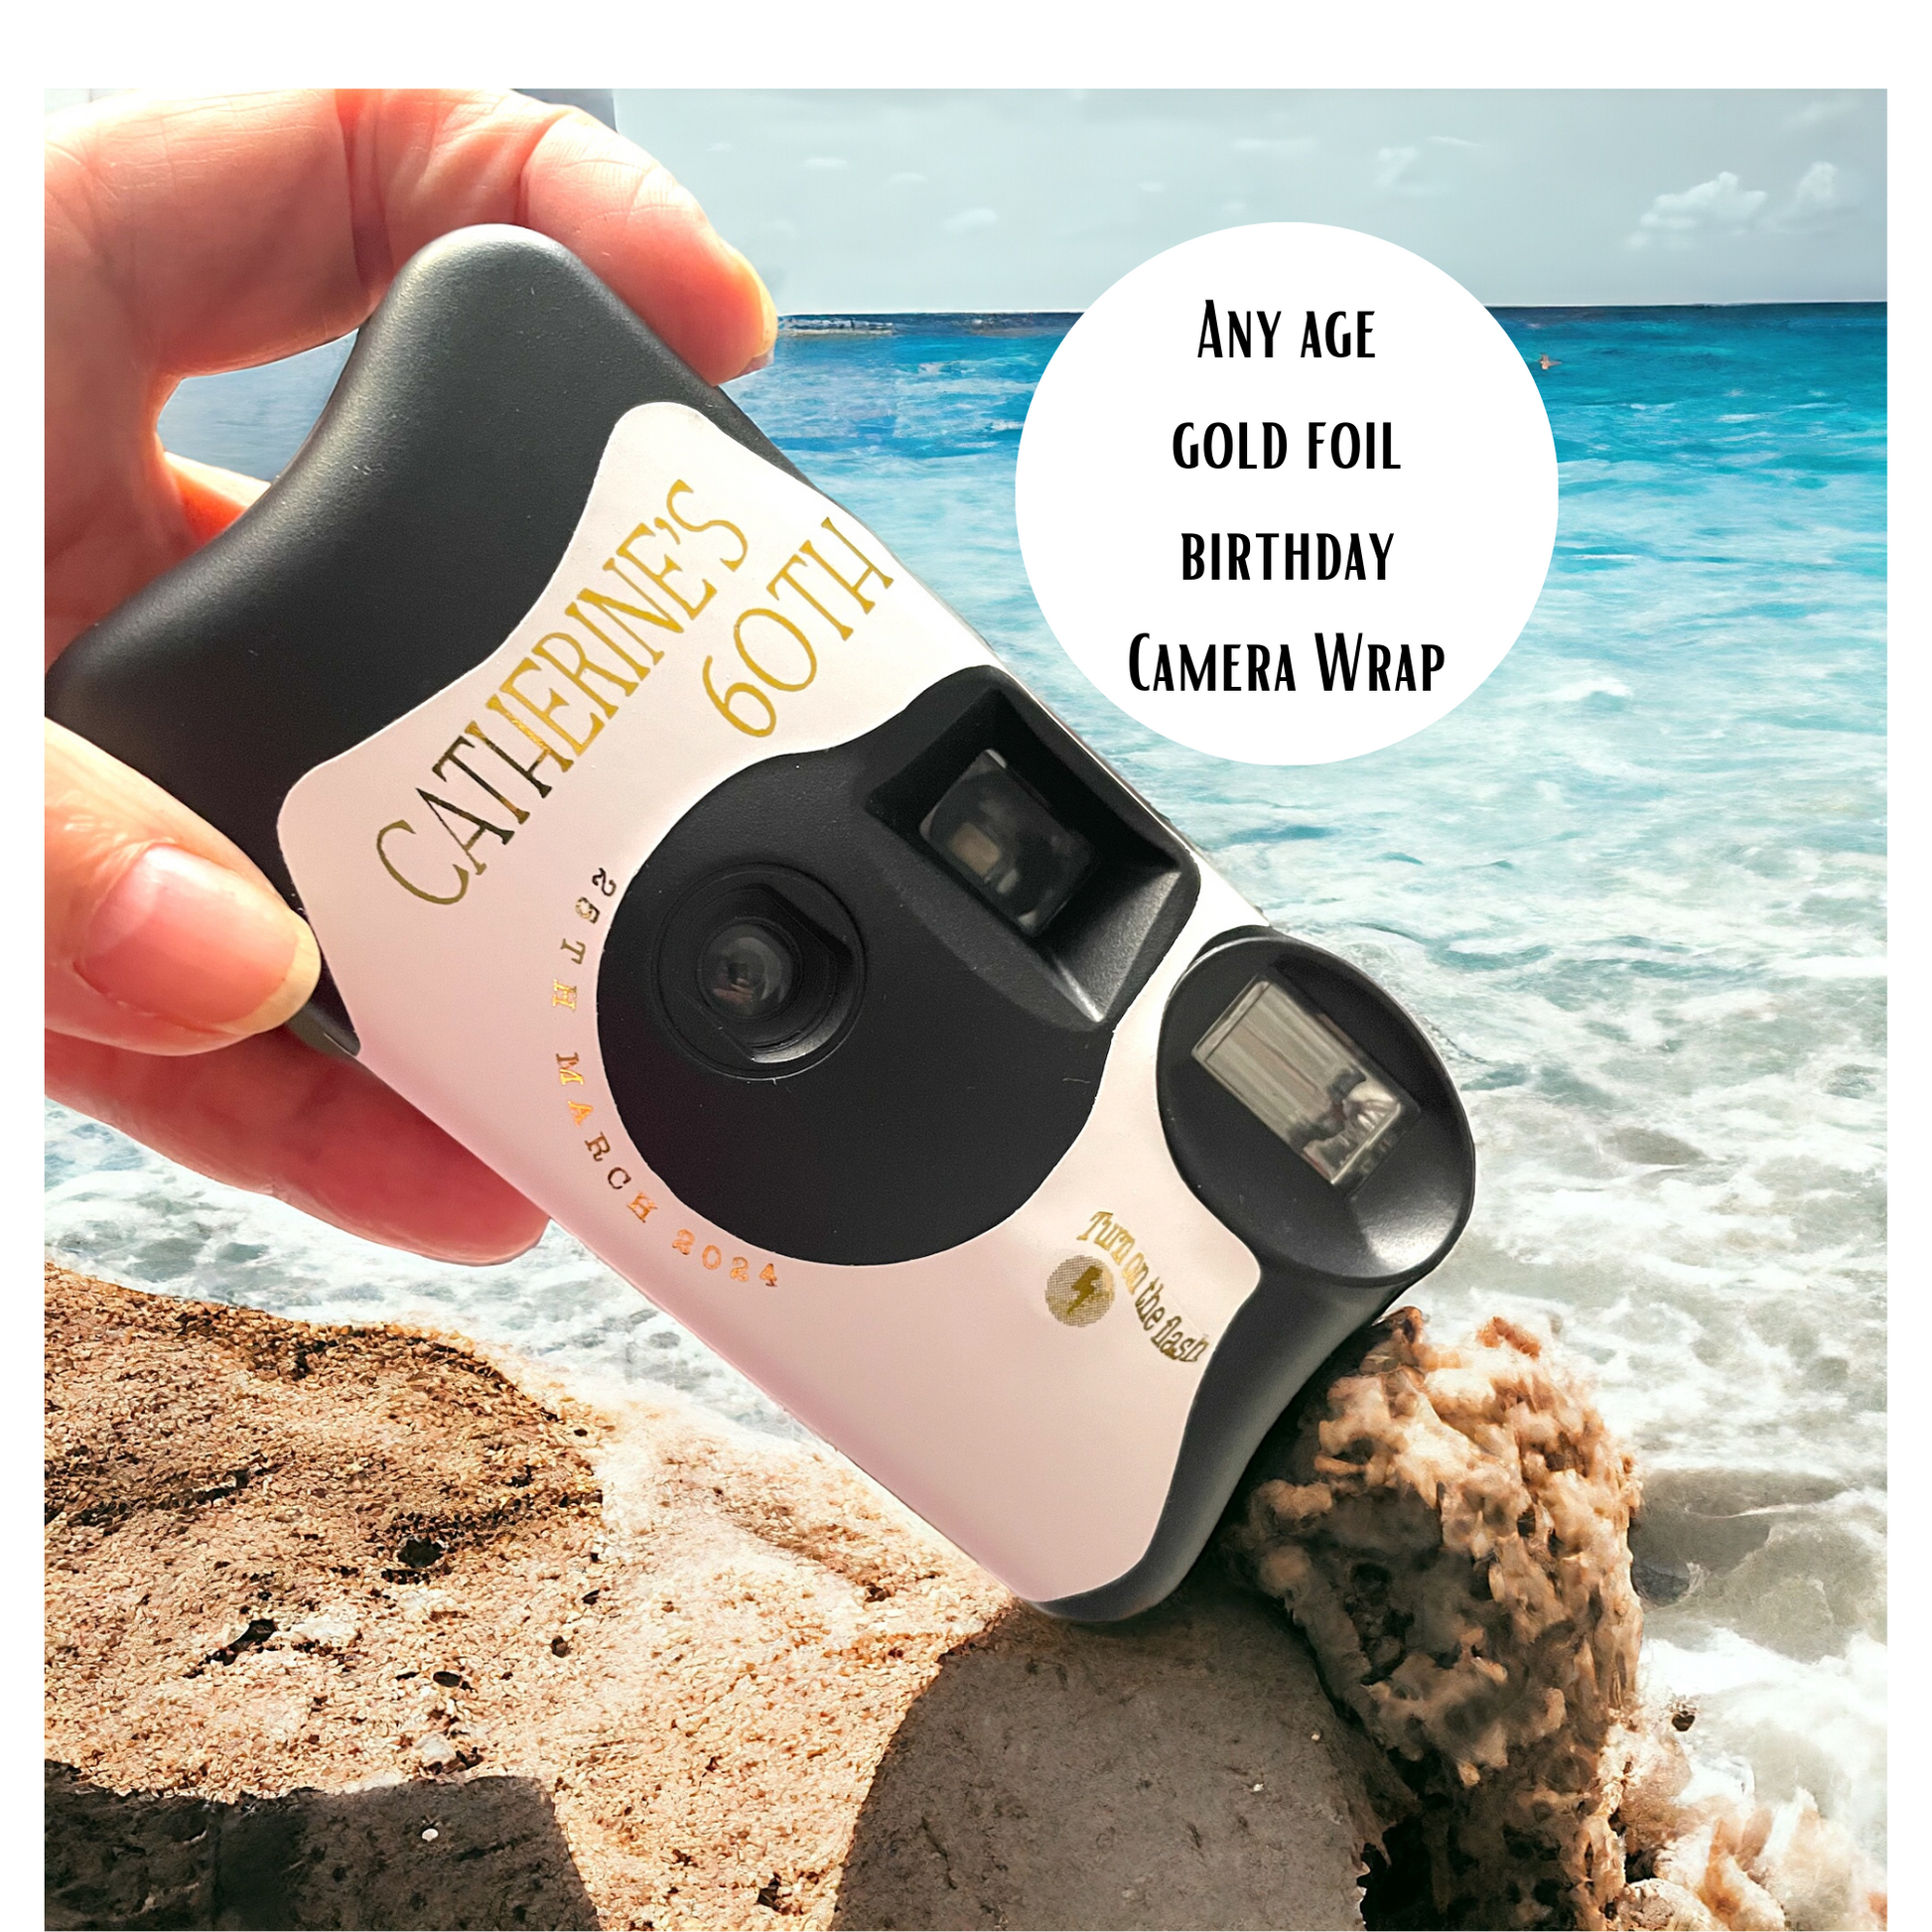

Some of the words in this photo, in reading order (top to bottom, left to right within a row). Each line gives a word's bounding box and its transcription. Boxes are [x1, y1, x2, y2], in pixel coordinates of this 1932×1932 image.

[702, 516, 894, 738] 60TH
[375, 479, 749, 905] CATHERINE'S
[552, 867, 618, 1011] 25TH
[556, 1052, 658, 1223] MARCH
[671, 1228, 778, 1288] 2024
[1076, 1211, 1135, 1265] Turn
[1122, 1252, 1149, 1295] on
[1135, 1277, 1166, 1330] the
[1151, 1315, 1209, 1363] flash
